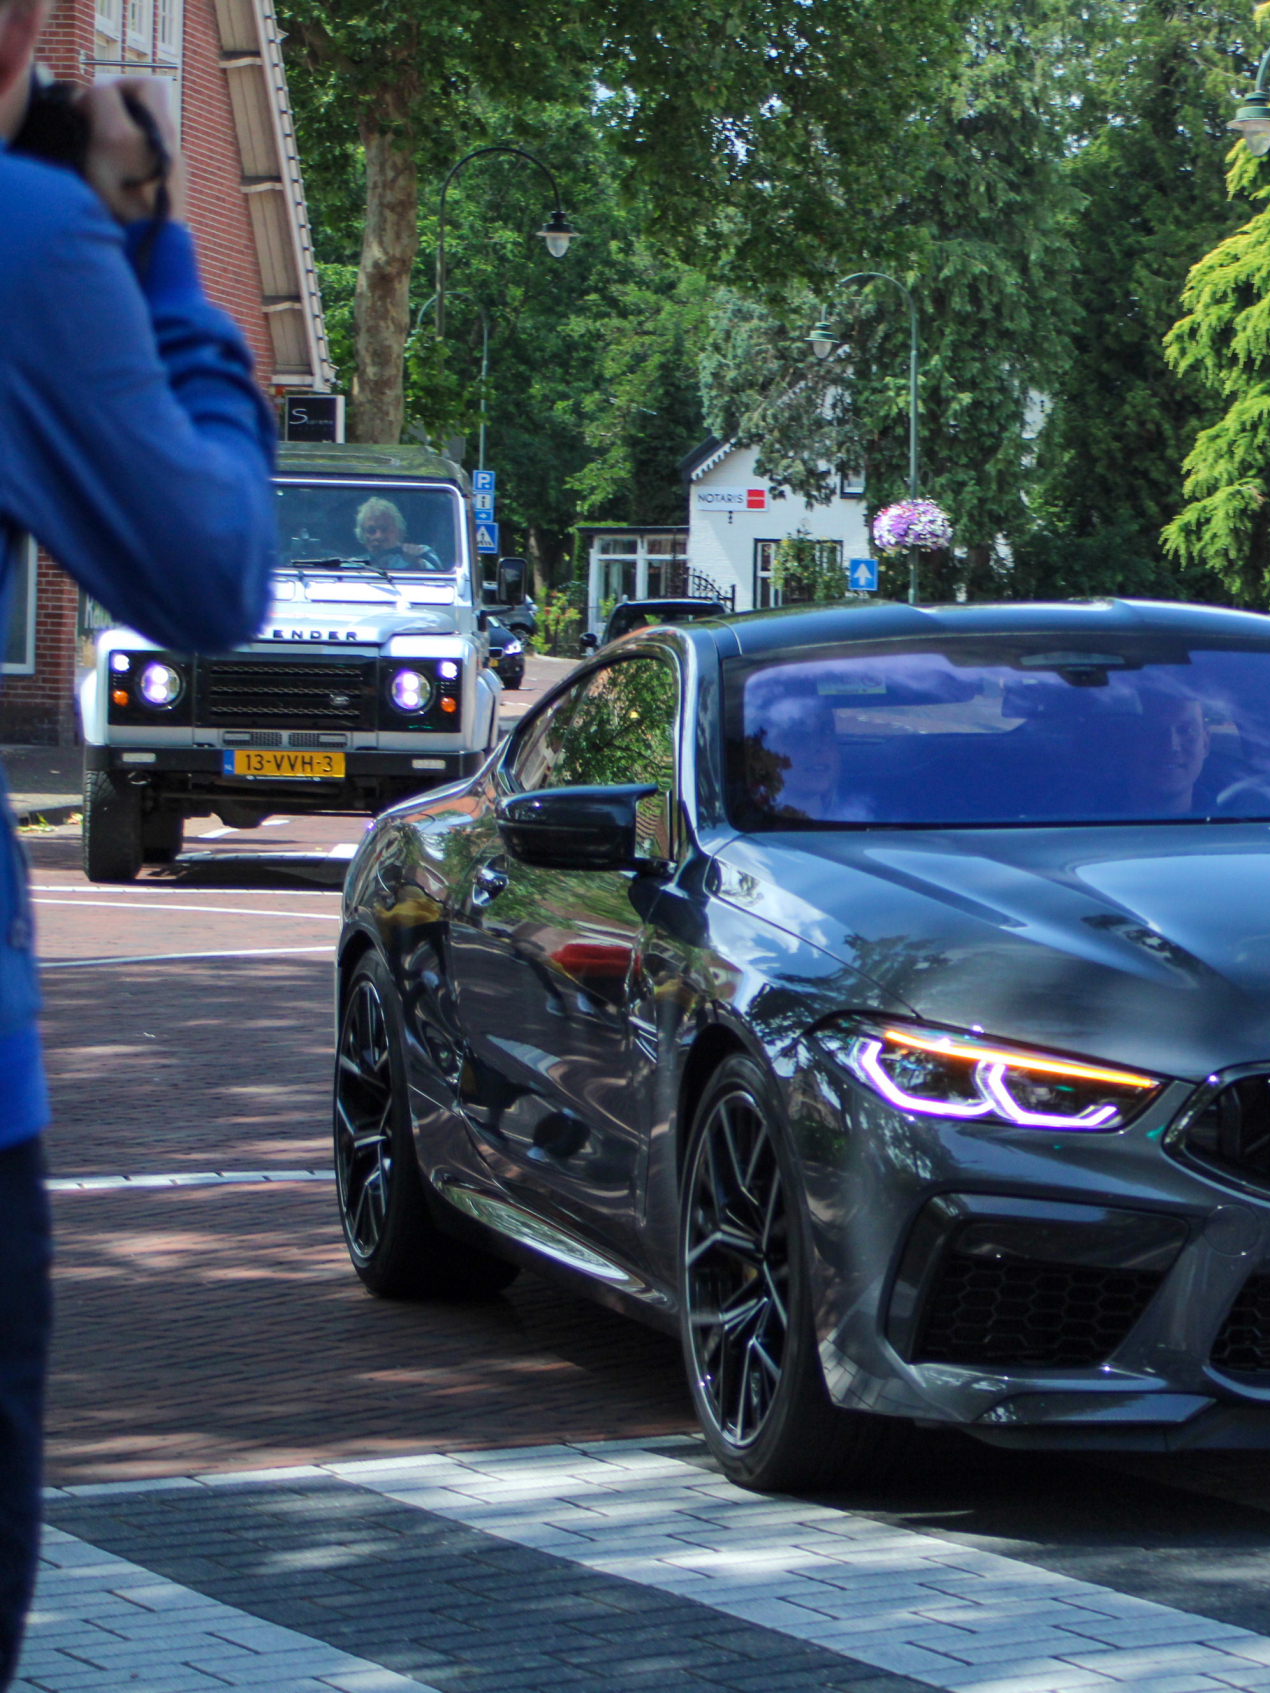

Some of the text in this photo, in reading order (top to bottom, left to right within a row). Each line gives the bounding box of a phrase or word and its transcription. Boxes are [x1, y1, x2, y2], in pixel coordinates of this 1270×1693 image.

[477, 473, 491, 489] P
[697, 493, 744, 504] NOTARIS
[273, 629, 358, 641] ENDER
[245, 753, 334, 773] 13-VVH-3
